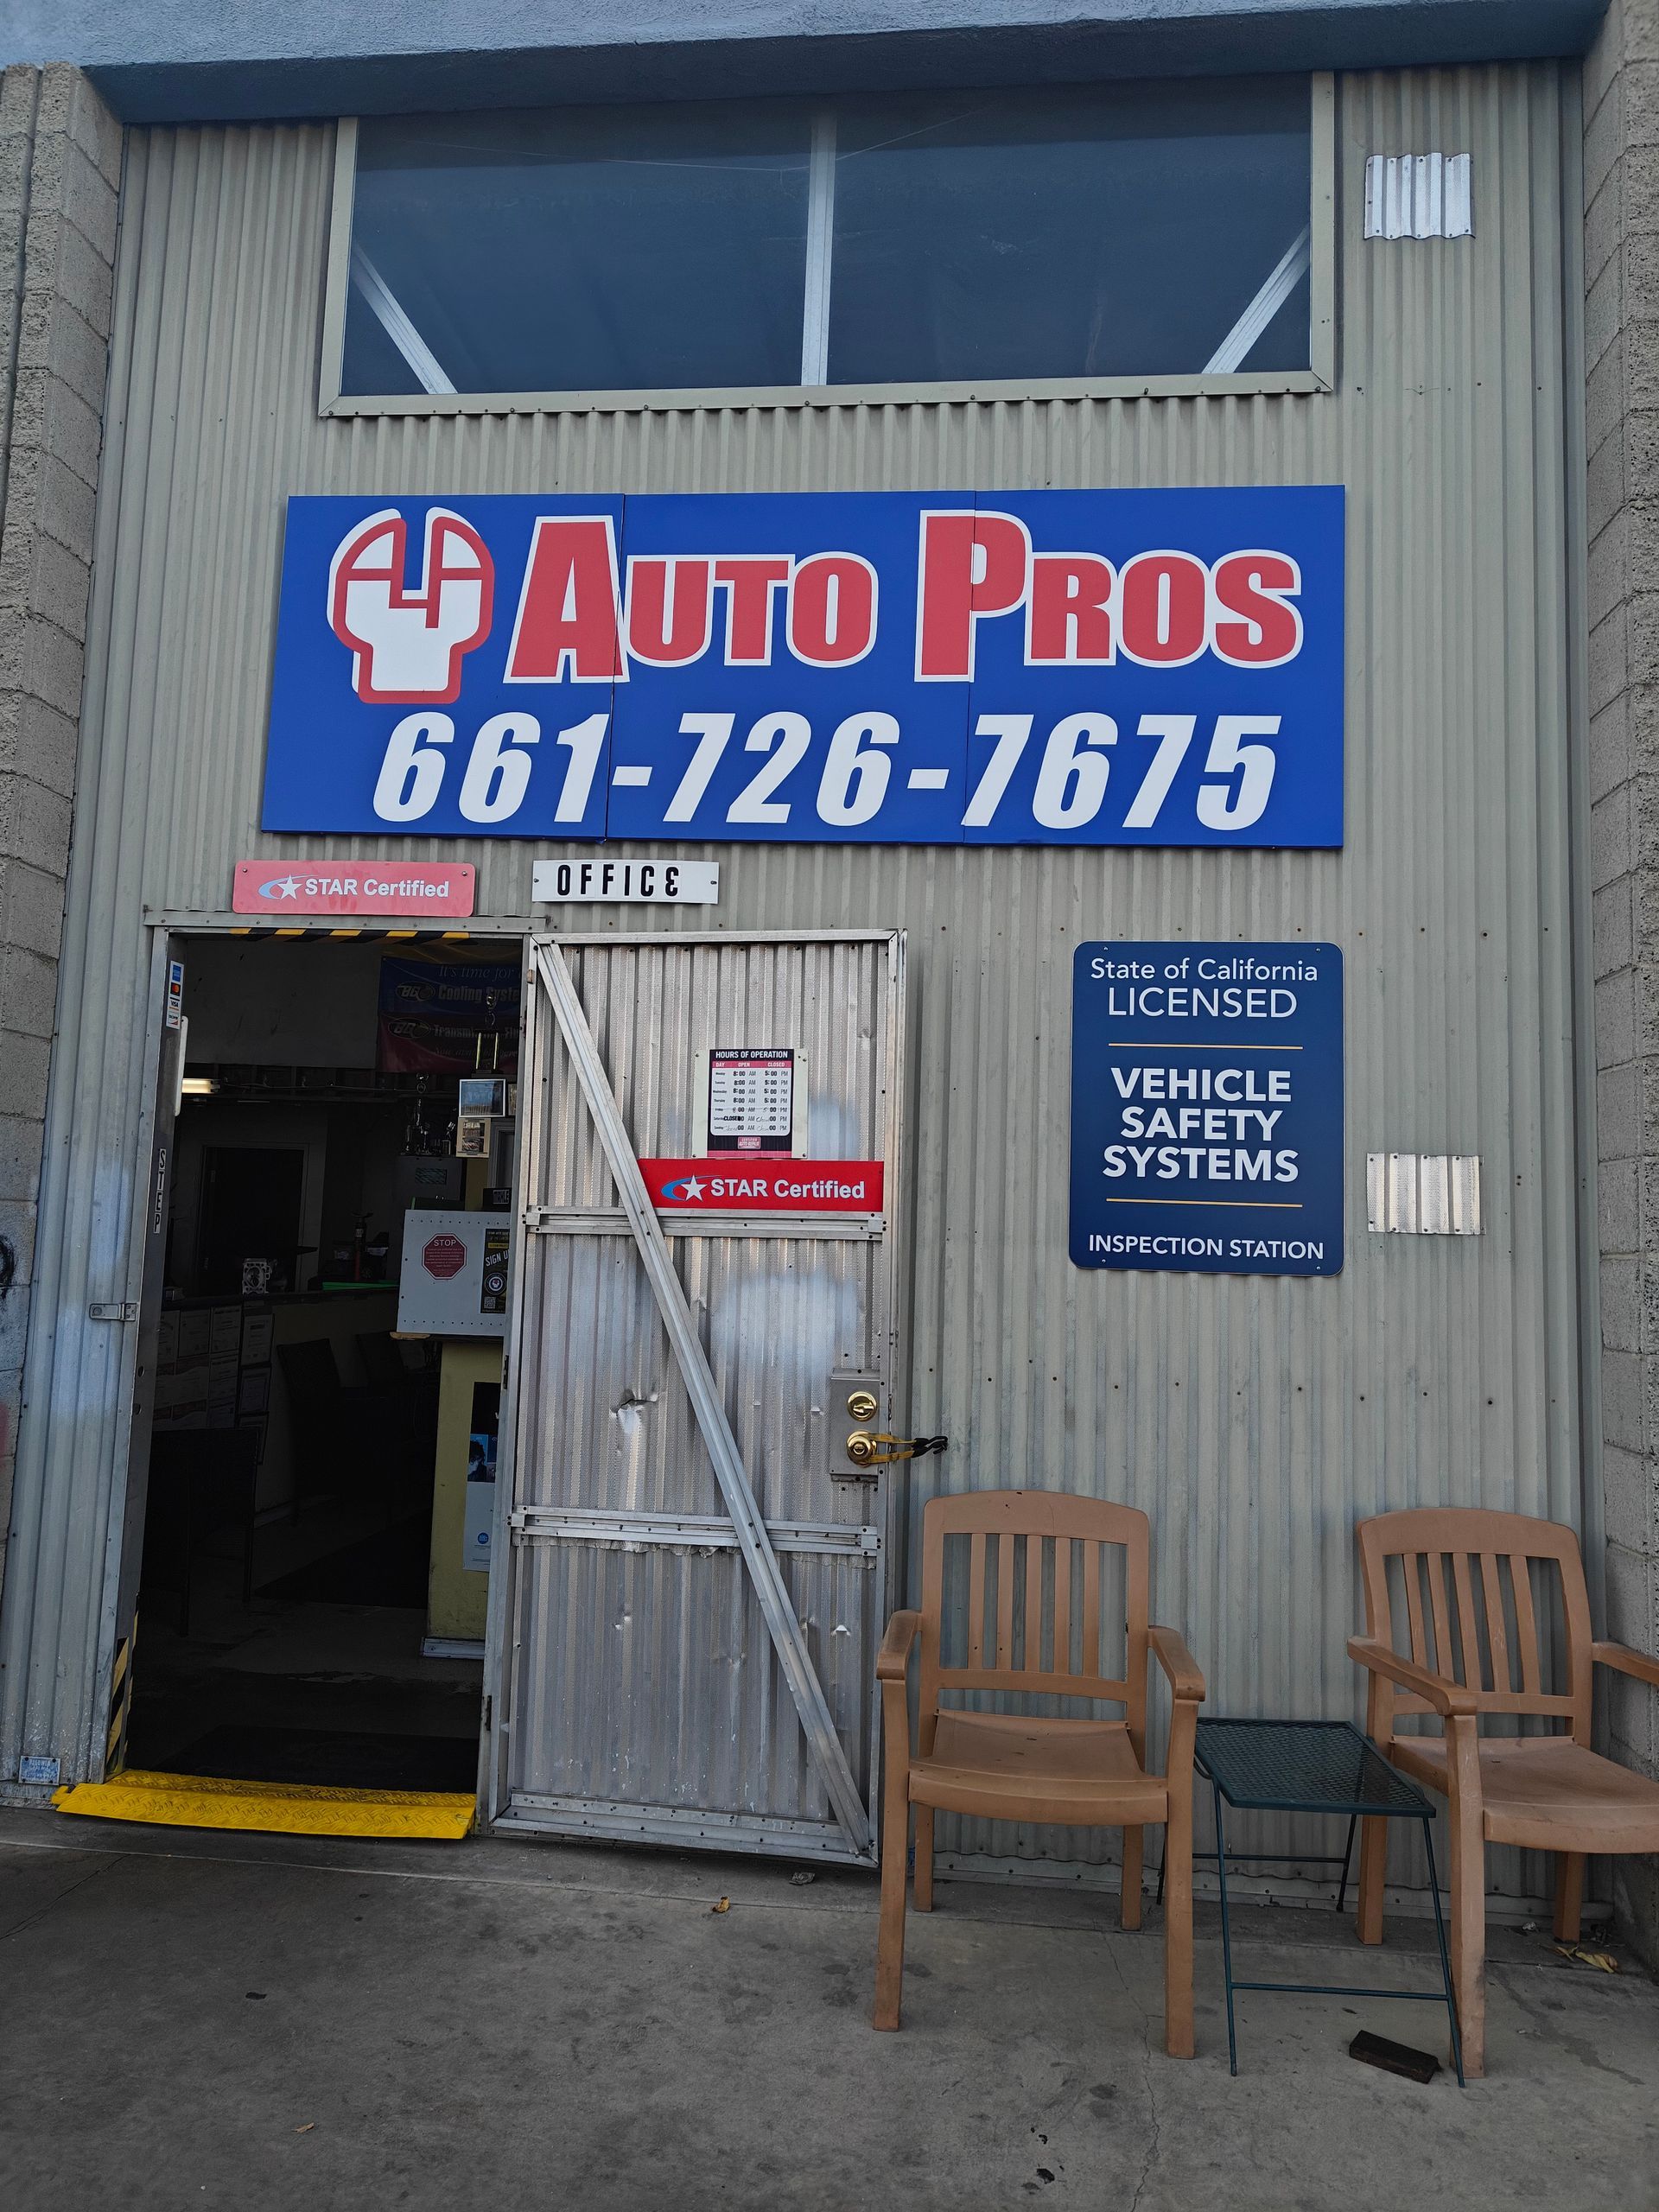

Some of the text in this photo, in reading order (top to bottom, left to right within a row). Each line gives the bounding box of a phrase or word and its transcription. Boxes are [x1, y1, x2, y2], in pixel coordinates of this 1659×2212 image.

[503, 509, 1303, 684] AUTO PROS
[373, 710, 1282, 830] 661-726-7675
[304, 878, 449, 899] STAR Certified
[556, 864, 679, 897] OFFICE
[1090, 957, 1319, 982] State of California
[438, 985, 483, 1003] Cooling
[1108, 987, 1298, 1018] LICENSED
[1110, 1067, 1292, 1103] VEHICLE
[1120, 1107, 1283, 1141] SAFETY
[1102, 1145, 1299, 1183] SYSTEMS
[155, 1150, 166, 1232] STEP
[710, 1179, 865, 1198] STAR Certified
[485, 1252, 502, 1267] SIGN
[1088, 1235, 1324, 1260] INSPECTION STATION
